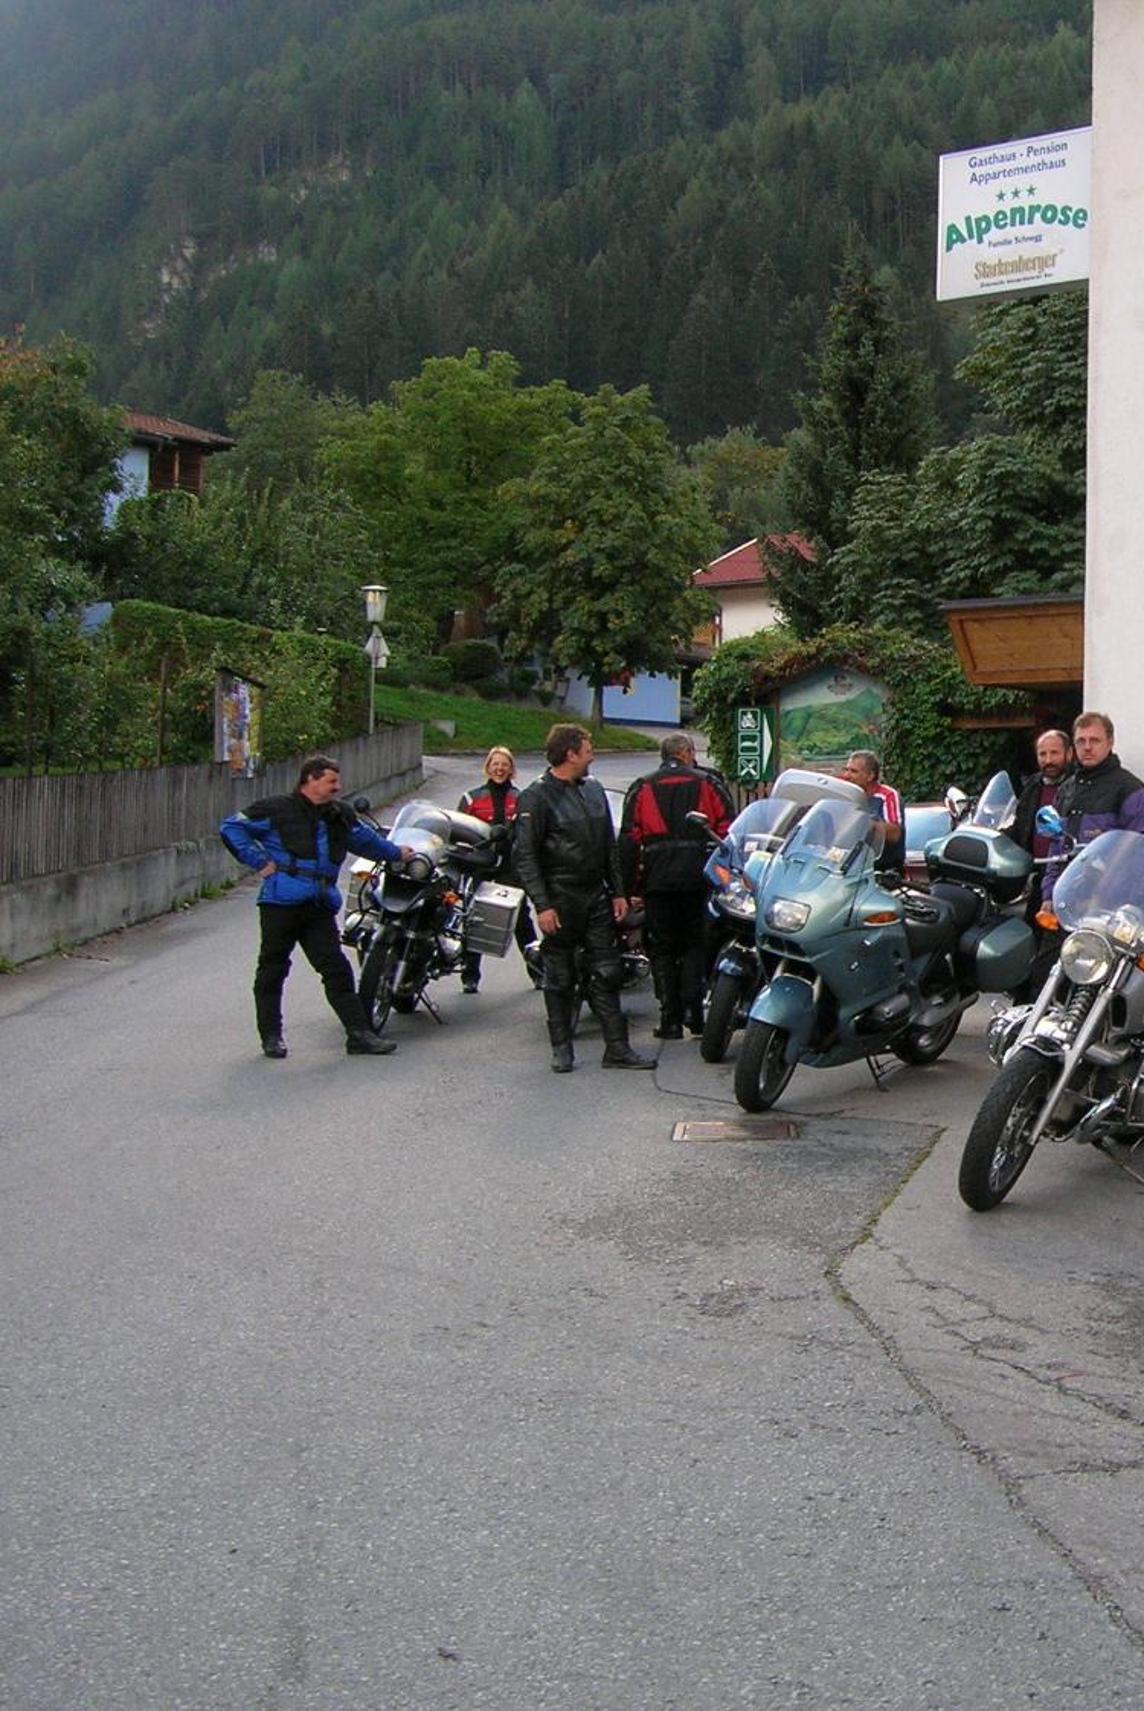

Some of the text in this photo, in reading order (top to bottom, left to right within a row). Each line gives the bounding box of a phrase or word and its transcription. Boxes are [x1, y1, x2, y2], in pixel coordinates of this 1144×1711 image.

[968, 152, 1016, 168] Gasthaus
[1026, 141, 1068, 157] Pension
[969, 159, 1066, 185] Appartementhaus
[945, 203, 1088, 252] Alpenrose
